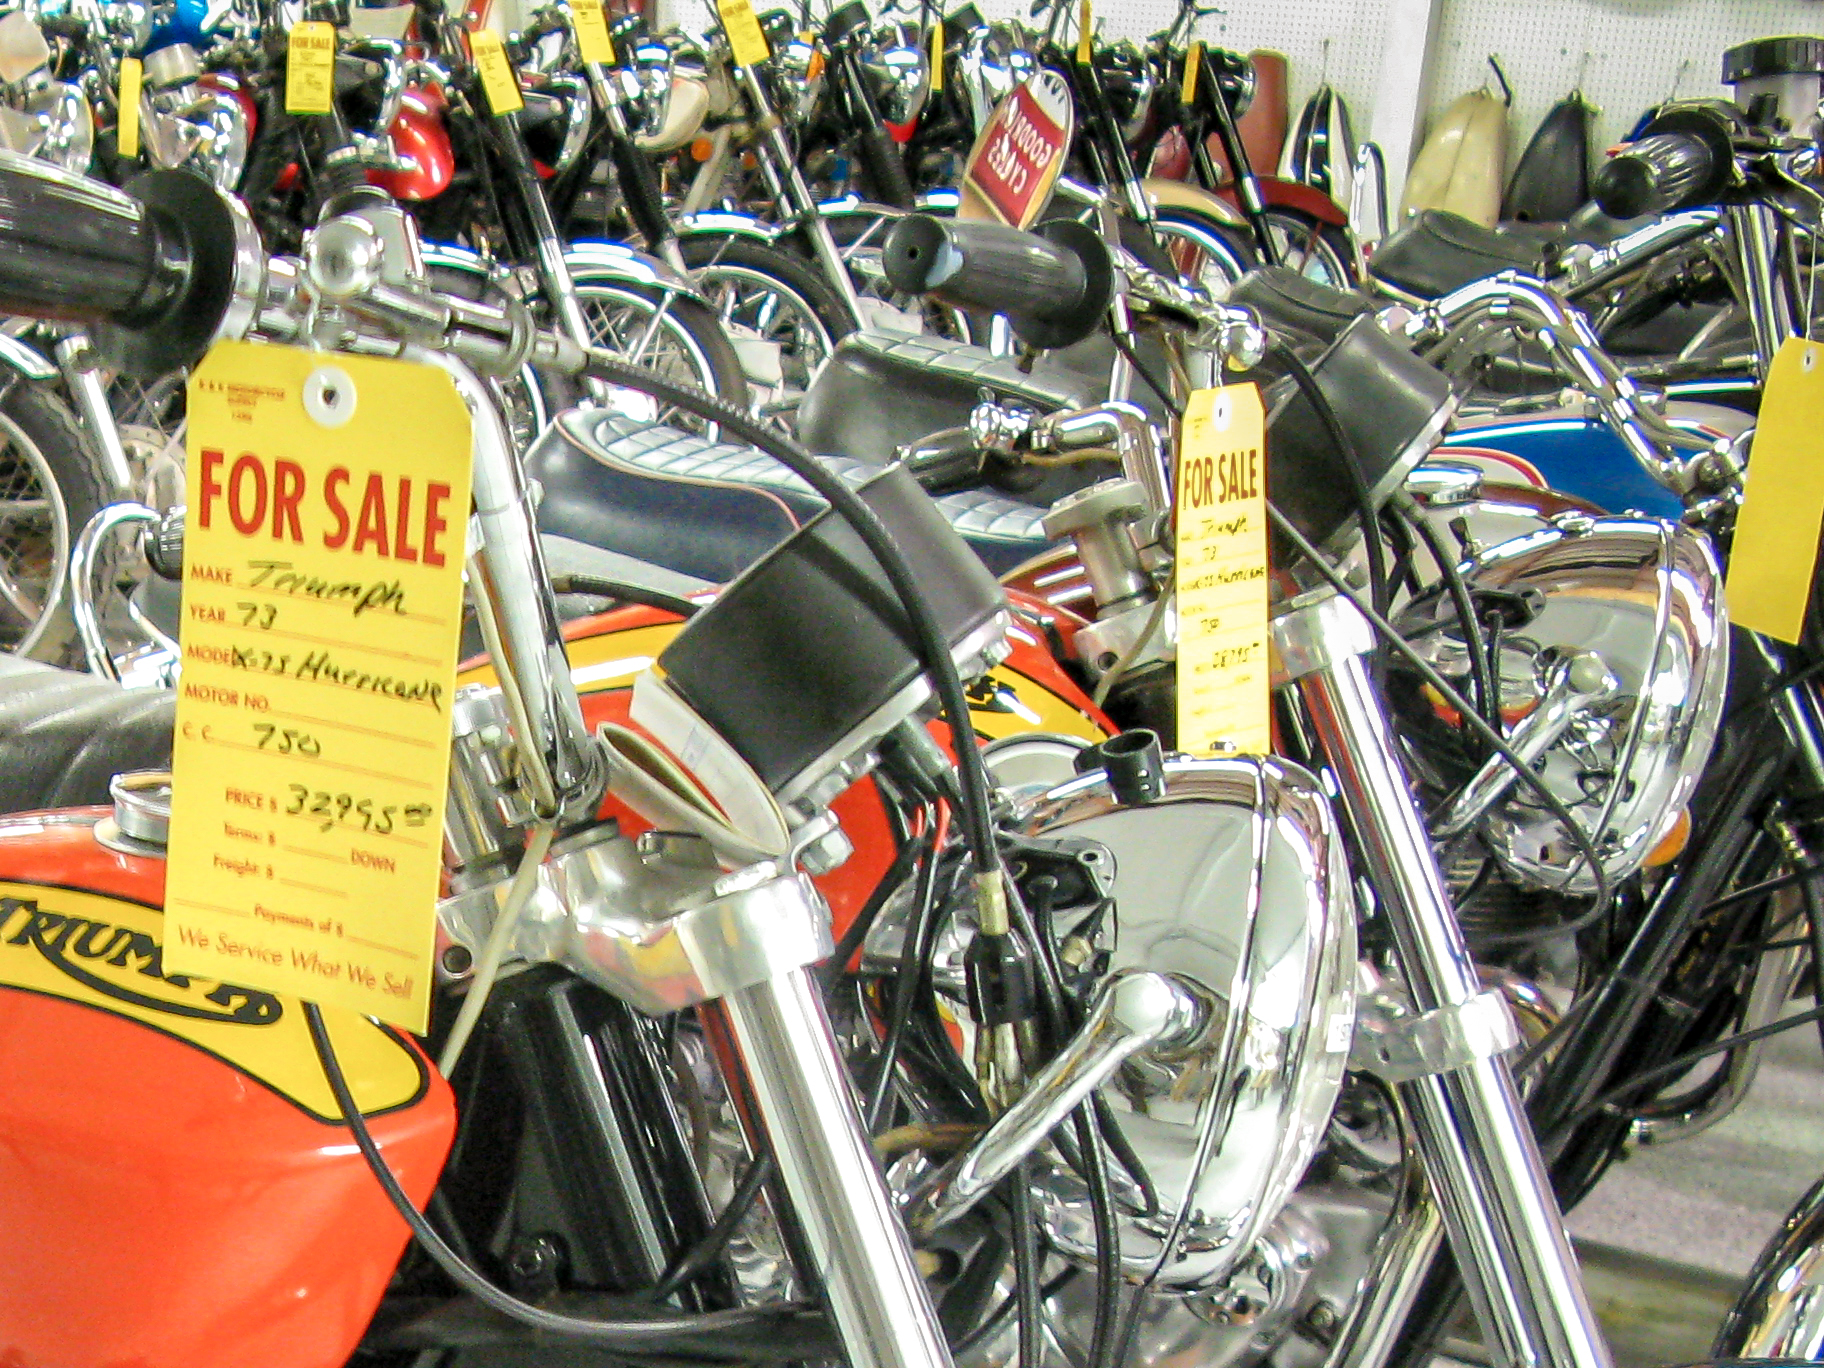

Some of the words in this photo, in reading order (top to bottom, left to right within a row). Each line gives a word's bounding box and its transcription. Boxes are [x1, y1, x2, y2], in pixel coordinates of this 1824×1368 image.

[1183, 456, 1213, 510] FOR
[1218, 449, 1257, 503] SALE
[199, 449, 305, 543] FOR
[323, 466, 451, 568] SALE
[190, 563, 233, 585] MAKE
[190, 604, 226, 623] YEAR
[237, 602, 277, 630] 73
[185, 682, 238, 707] MOTOR
[295, 650, 442, 714] Hurricane
[254, 722, 321, 758] 750
[225, 787, 263, 810] PRICE
[351, 848, 395, 873] DOWN
[178, 924, 209, 948] We
[216, 932, 283, 966] Service
[291, 946, 341, 977] What
[348, 961, 376, 989] We
[383, 971, 414, 1000] Sell
